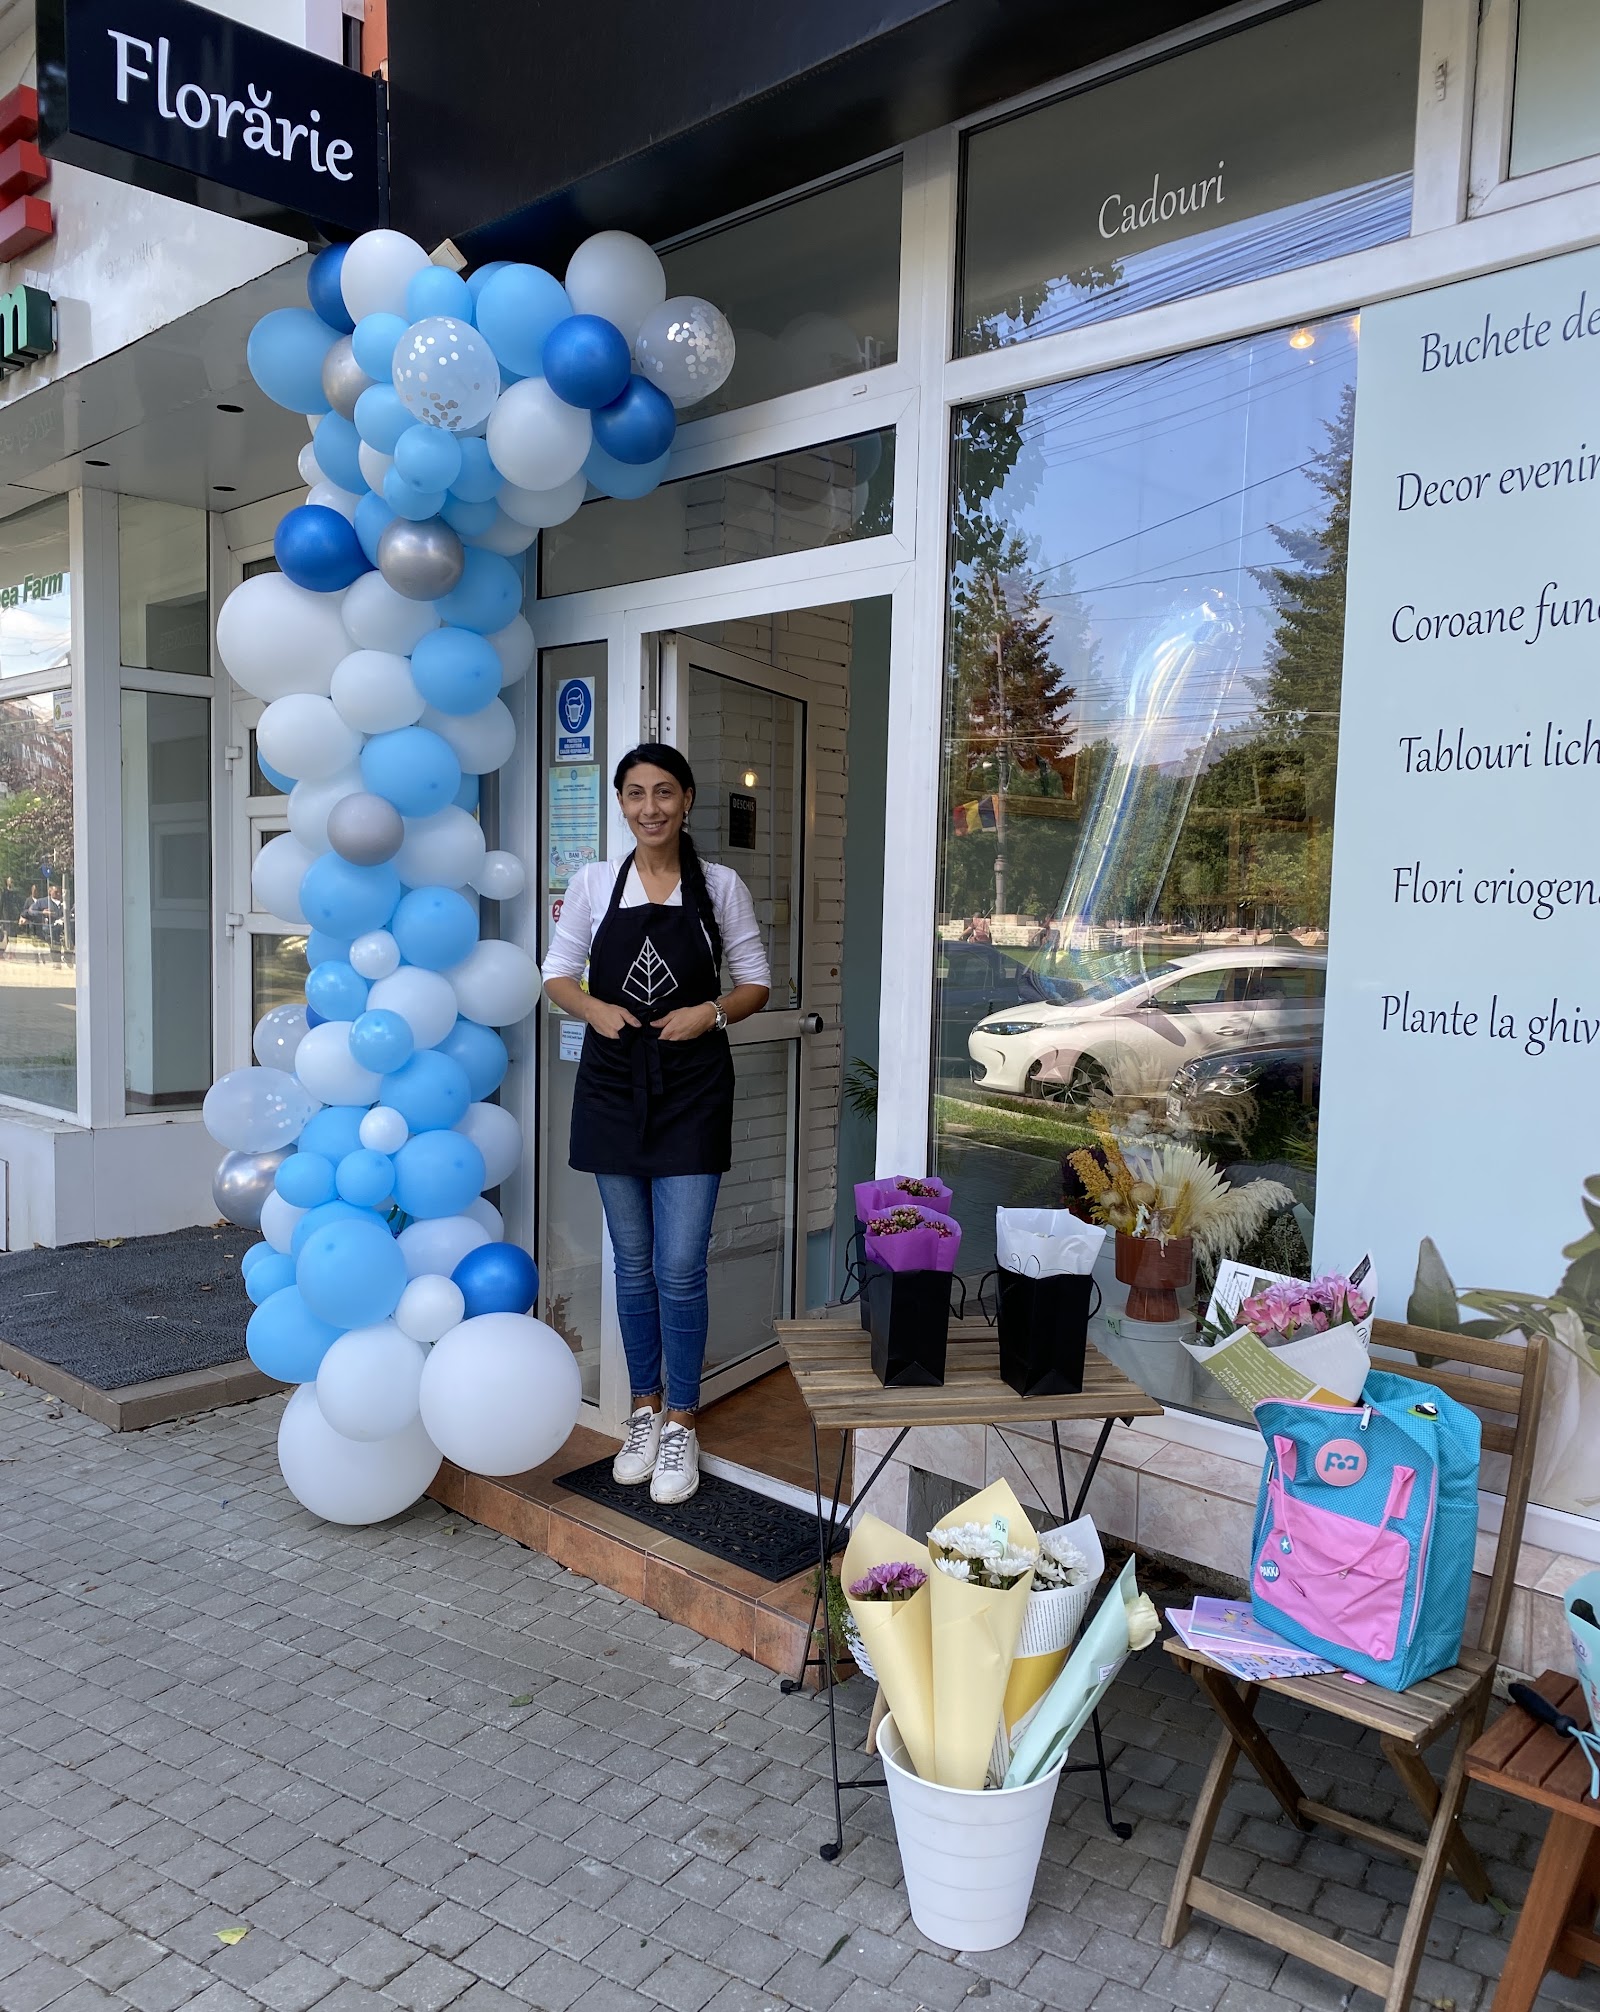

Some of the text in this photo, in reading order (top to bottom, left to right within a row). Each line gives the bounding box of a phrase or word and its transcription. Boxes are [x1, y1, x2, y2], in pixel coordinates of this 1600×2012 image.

[107, 29, 354, 181] Florărie
[1098, 160, 1226, 239] Cadouri
[1420, 290, 1600, 373] Buchete de
[1396, 471, 1492, 512] Decor
[23, 572, 63, 603] Farm
[1391, 581, 1600, 645] Coroane fun
[1399, 727, 1532, 773] Tablouri
[1393, 861, 1600, 920] Flori criogen
[1381, 990, 1478, 1036] Plante
[1489, 995, 1517, 1039] la
